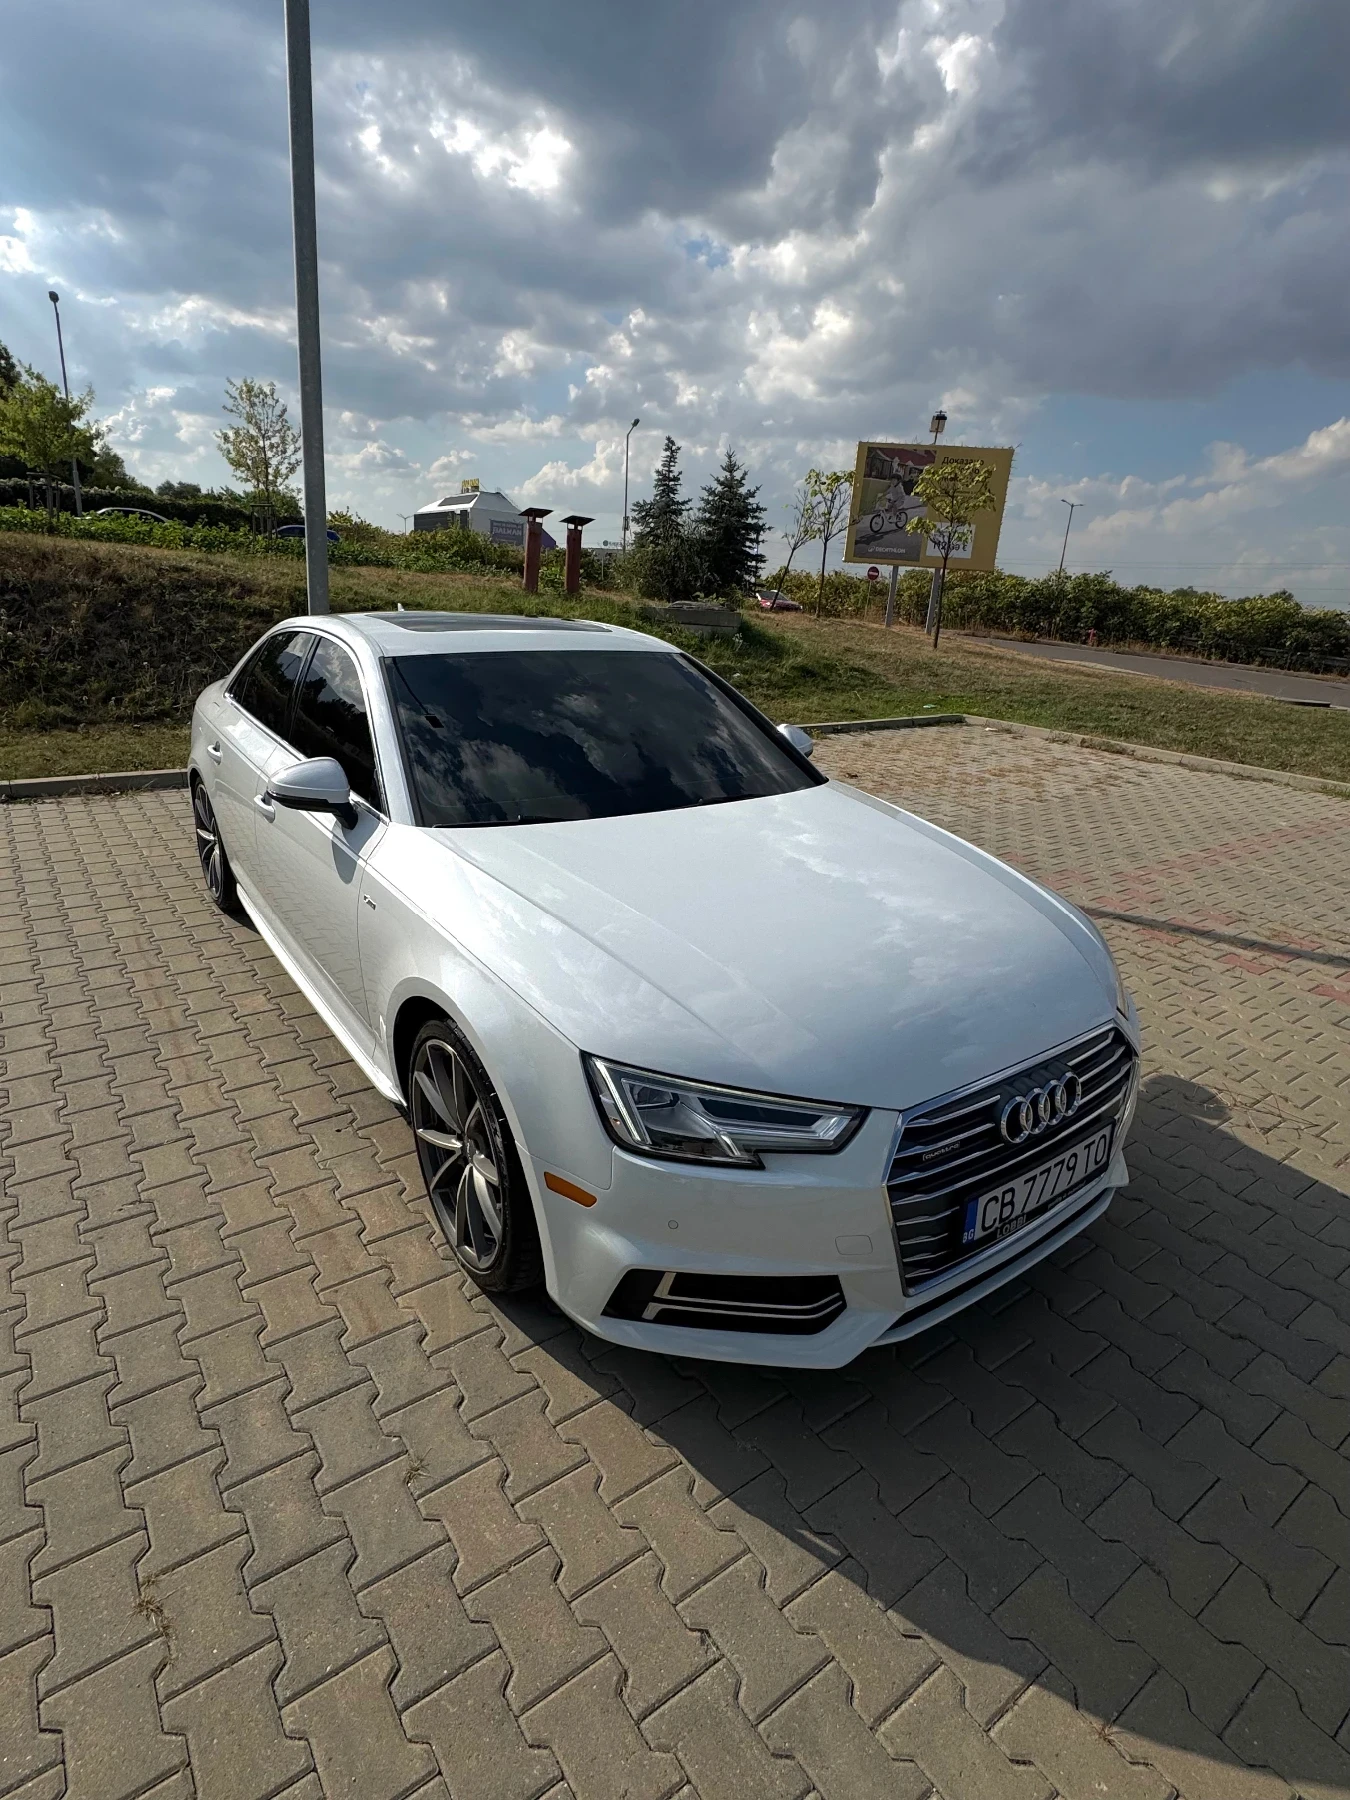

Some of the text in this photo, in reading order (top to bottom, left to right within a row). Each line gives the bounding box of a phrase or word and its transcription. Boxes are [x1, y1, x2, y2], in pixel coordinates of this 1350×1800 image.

[875, 546, 906, 554] DECATHLON
[962, 1228, 975, 1244] BG
[981, 1187, 1016, 1232] CB
[1021, 1152, 1078, 1214] 7779
[1083, 1134, 1107, 1174] TO
